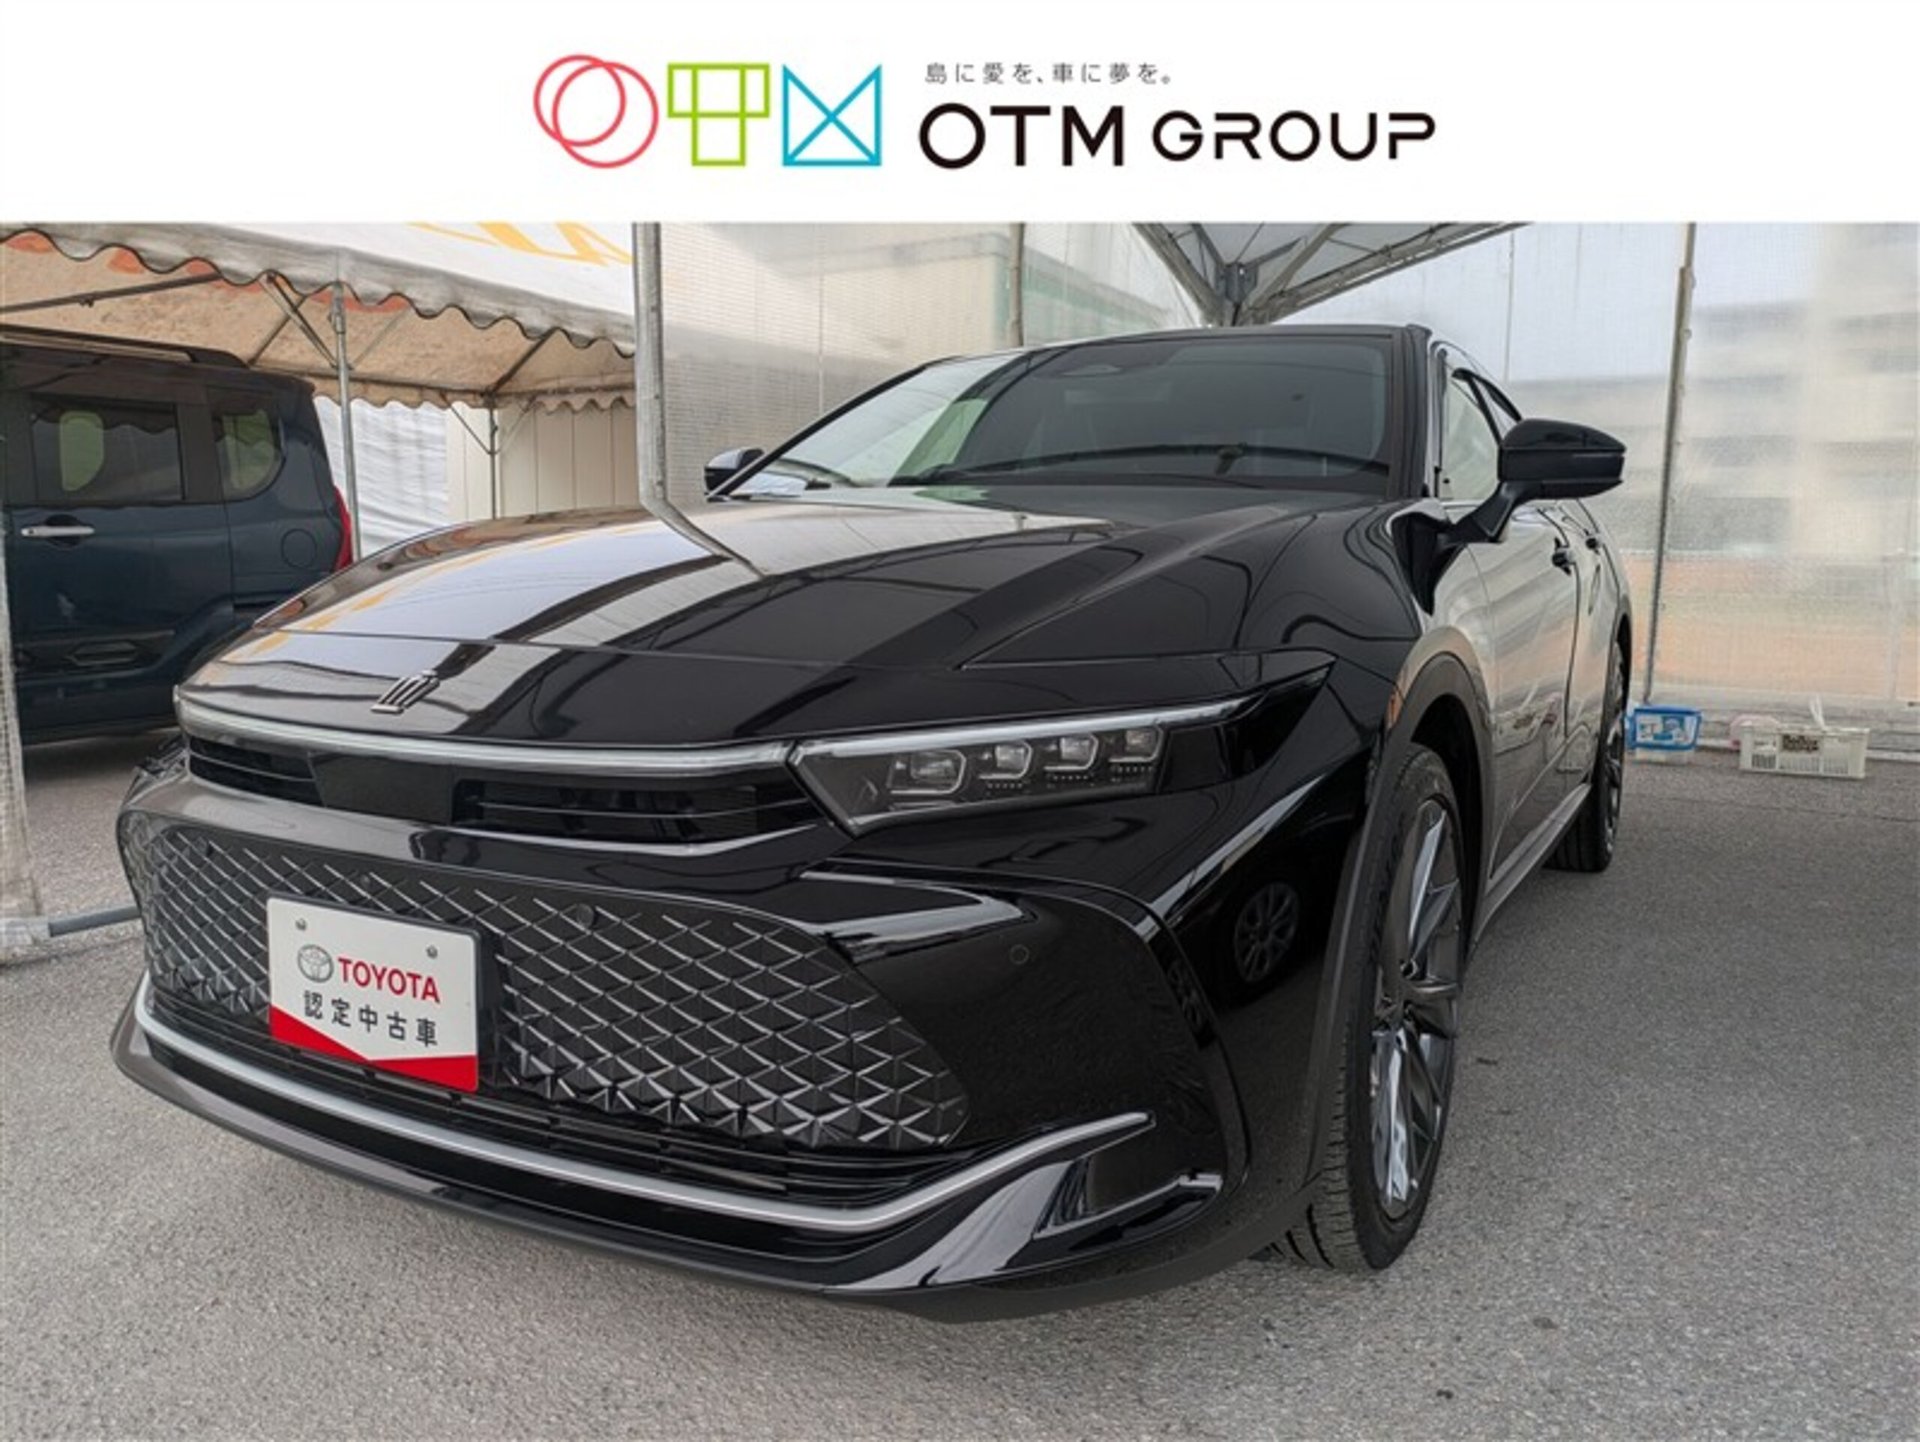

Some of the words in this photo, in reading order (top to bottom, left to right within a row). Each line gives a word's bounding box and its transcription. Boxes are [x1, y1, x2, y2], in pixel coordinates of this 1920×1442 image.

[338, 957, 441, 1004] TOYOTA
[304, 990, 438, 1047] 認定中古車
